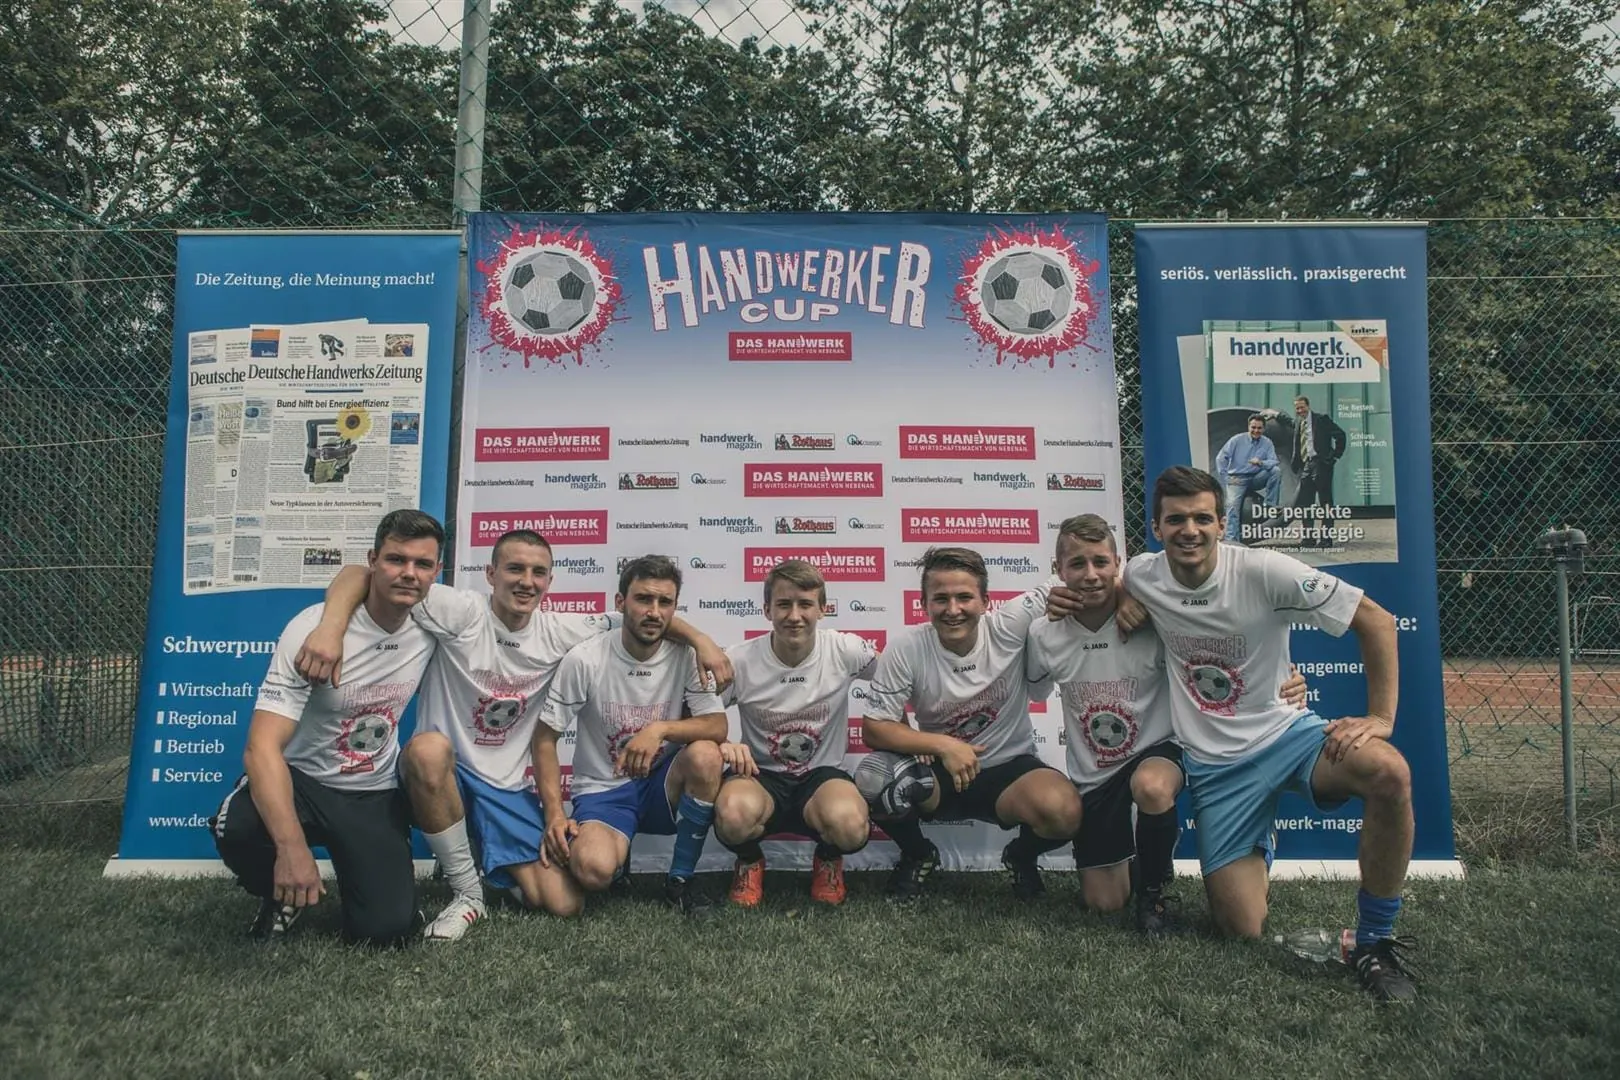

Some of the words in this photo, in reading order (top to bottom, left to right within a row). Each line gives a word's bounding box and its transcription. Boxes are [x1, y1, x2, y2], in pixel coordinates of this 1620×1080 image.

[195, 273, 221, 286] Die
[224, 273, 285, 289] Zeitung,
[289, 272, 312, 286] die
[315, 273, 381, 289] Meinung
[384, 271, 435, 286] macht!
[1161, 266, 1209, 281] seriös.
[1214, 266, 1298, 281] verlässlich.
[1304, 266, 1406, 283] praxisgerecht
[642, 240, 932, 332] HANDWERKER
[740, 299, 840, 324] CUP
[736, 338, 763, 348] DAS
[767, 336, 844, 348] HANDWERK
[1230, 337, 1343, 356] handwerk
[1286, 353, 1362, 374] magazin
[190, 368, 246, 387] Deutsche
[276, 400, 297, 409] Bund
[298, 399, 314, 408] hilft
[315, 399, 328, 408] bei
[329, 399, 390, 411] Energieeffizienz
[483, 437, 512, 447] DAS
[517, 434, 601, 446] HANDWERK
[700, 433, 754, 443] handwerk
[908, 434, 937, 444] DAS
[942, 431, 1026, 445] HANDWERK
[726, 440, 762, 451] magazin
[545, 473, 598, 483] handwerk
[753, 472, 783, 482] DAS
[788, 468, 874, 482] HANDWERK
[973, 471, 1027, 482] handwerk
[570, 480, 607, 491] magazin
[1000, 480, 1035, 490] magazin
[1251, 504, 1278, 519] Die
[1283, 504, 1352, 522] perfekte
[479, 520, 508, 531] DAS
[513, 516, 598, 530] HANDWERK
[699, 516, 754, 526] handwerk
[910, 517, 940, 527] DAS
[945, 514, 1030, 528] HANDWERK
[726, 523, 762, 534] magazin
[1241, 524, 1365, 543] Bilanzstrategie
[984, 556, 1030, 566] andwerk
[568, 565, 605, 576] magazin
[1003, 563, 1039, 574] magazin
[699, 599, 754, 609] handwerk
[726, 605, 763, 617] magazin
[163, 636, 276, 658] Schwerpun
[504, 641, 520, 649] JAKO
[960, 664, 976, 673] JAKO
[1296, 662, 1365, 677] nagemen
[172, 682, 254, 697] Wirtschaft
[168, 710, 237, 729] Regional
[167, 739, 225, 754] Betrieb
[164, 768, 223, 783] Service
[149, 813, 210, 827] www.de
